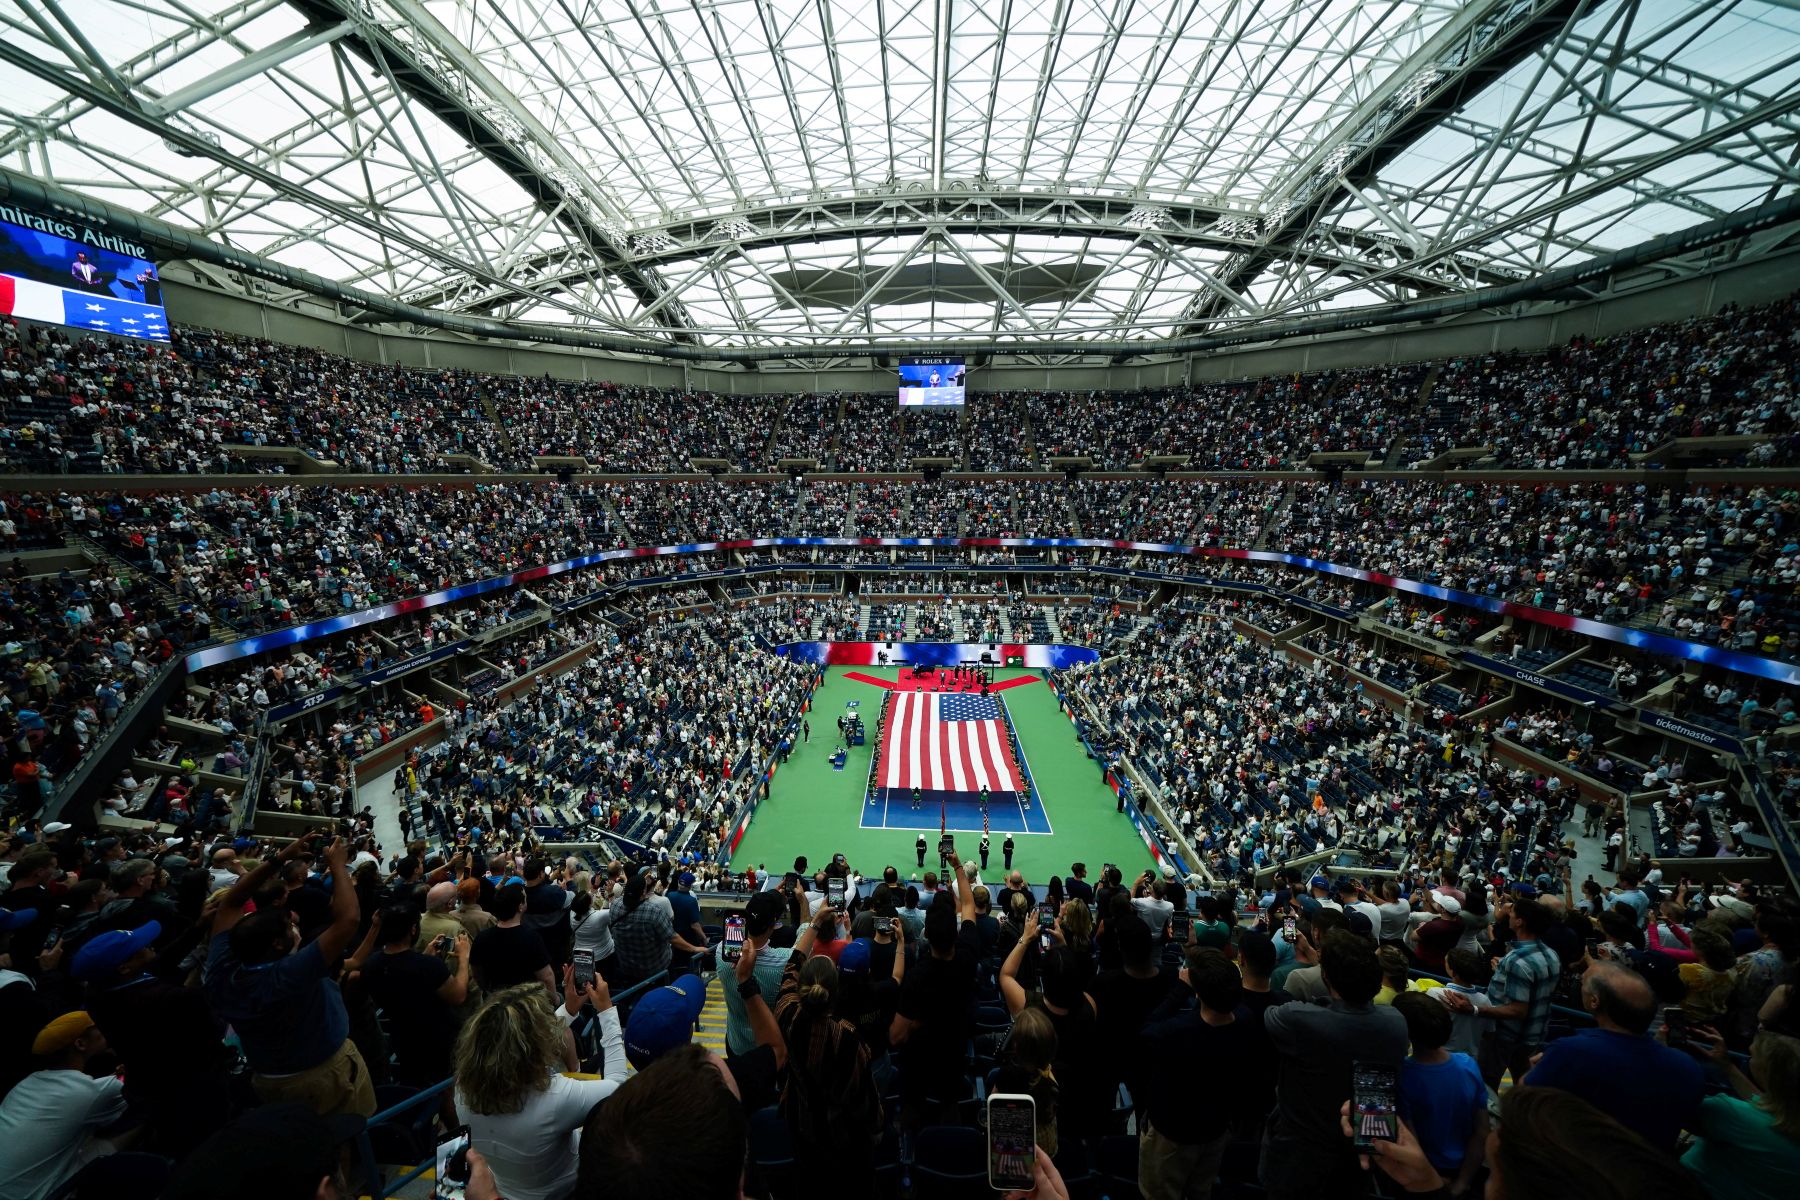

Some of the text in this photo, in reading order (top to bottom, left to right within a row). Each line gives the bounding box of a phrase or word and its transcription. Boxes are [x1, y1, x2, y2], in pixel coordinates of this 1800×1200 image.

[0, 205, 147, 260] mirates Airline
[386, 656, 432, 676] AMERICAN EXPRESS
[1516, 671, 1545, 687] CHASE
[302, 693, 325, 709] ATP
[1655, 718, 1717, 744] ticketmaster
